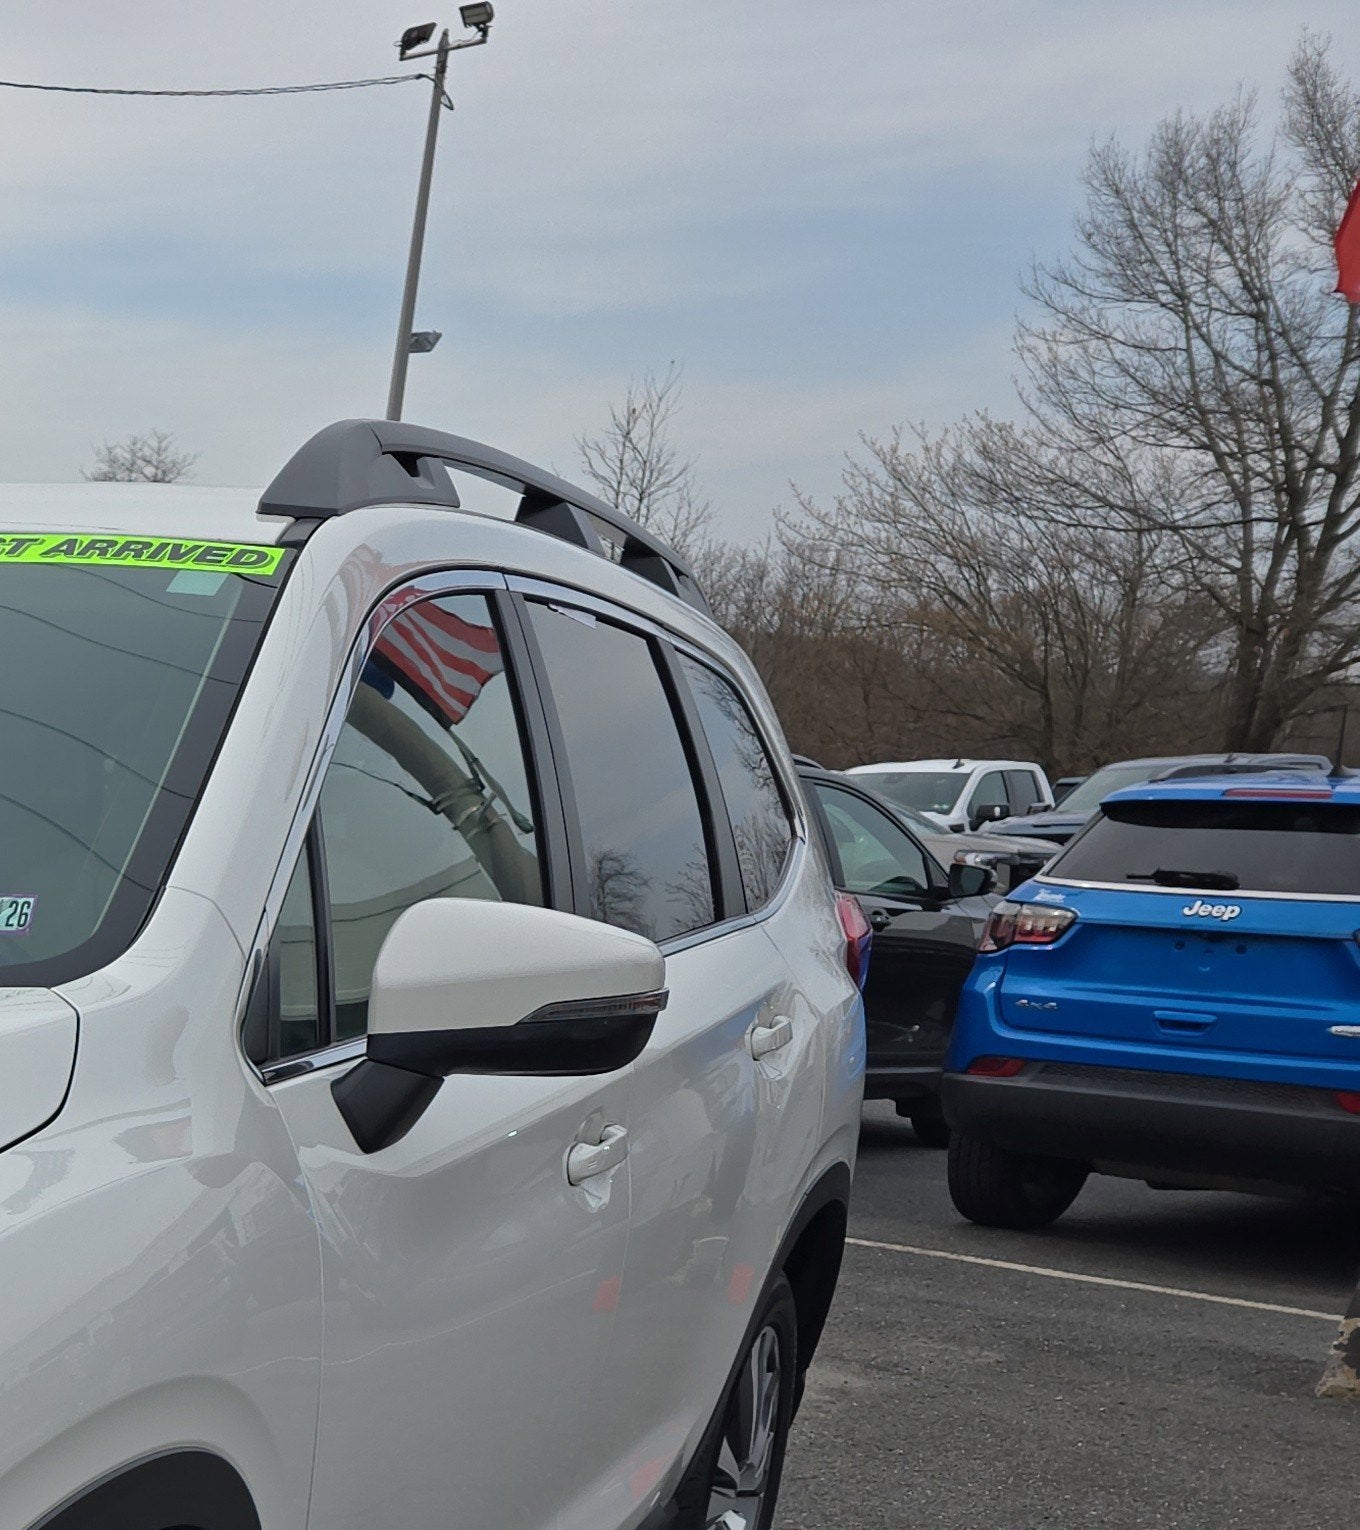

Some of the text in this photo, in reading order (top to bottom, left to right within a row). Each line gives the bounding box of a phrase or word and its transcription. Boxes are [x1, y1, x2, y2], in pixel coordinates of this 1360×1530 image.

[39, 538, 275, 569] ARRIVED
[5, 900, 32, 928] 26
[1183, 900, 1242, 921] Jeep
